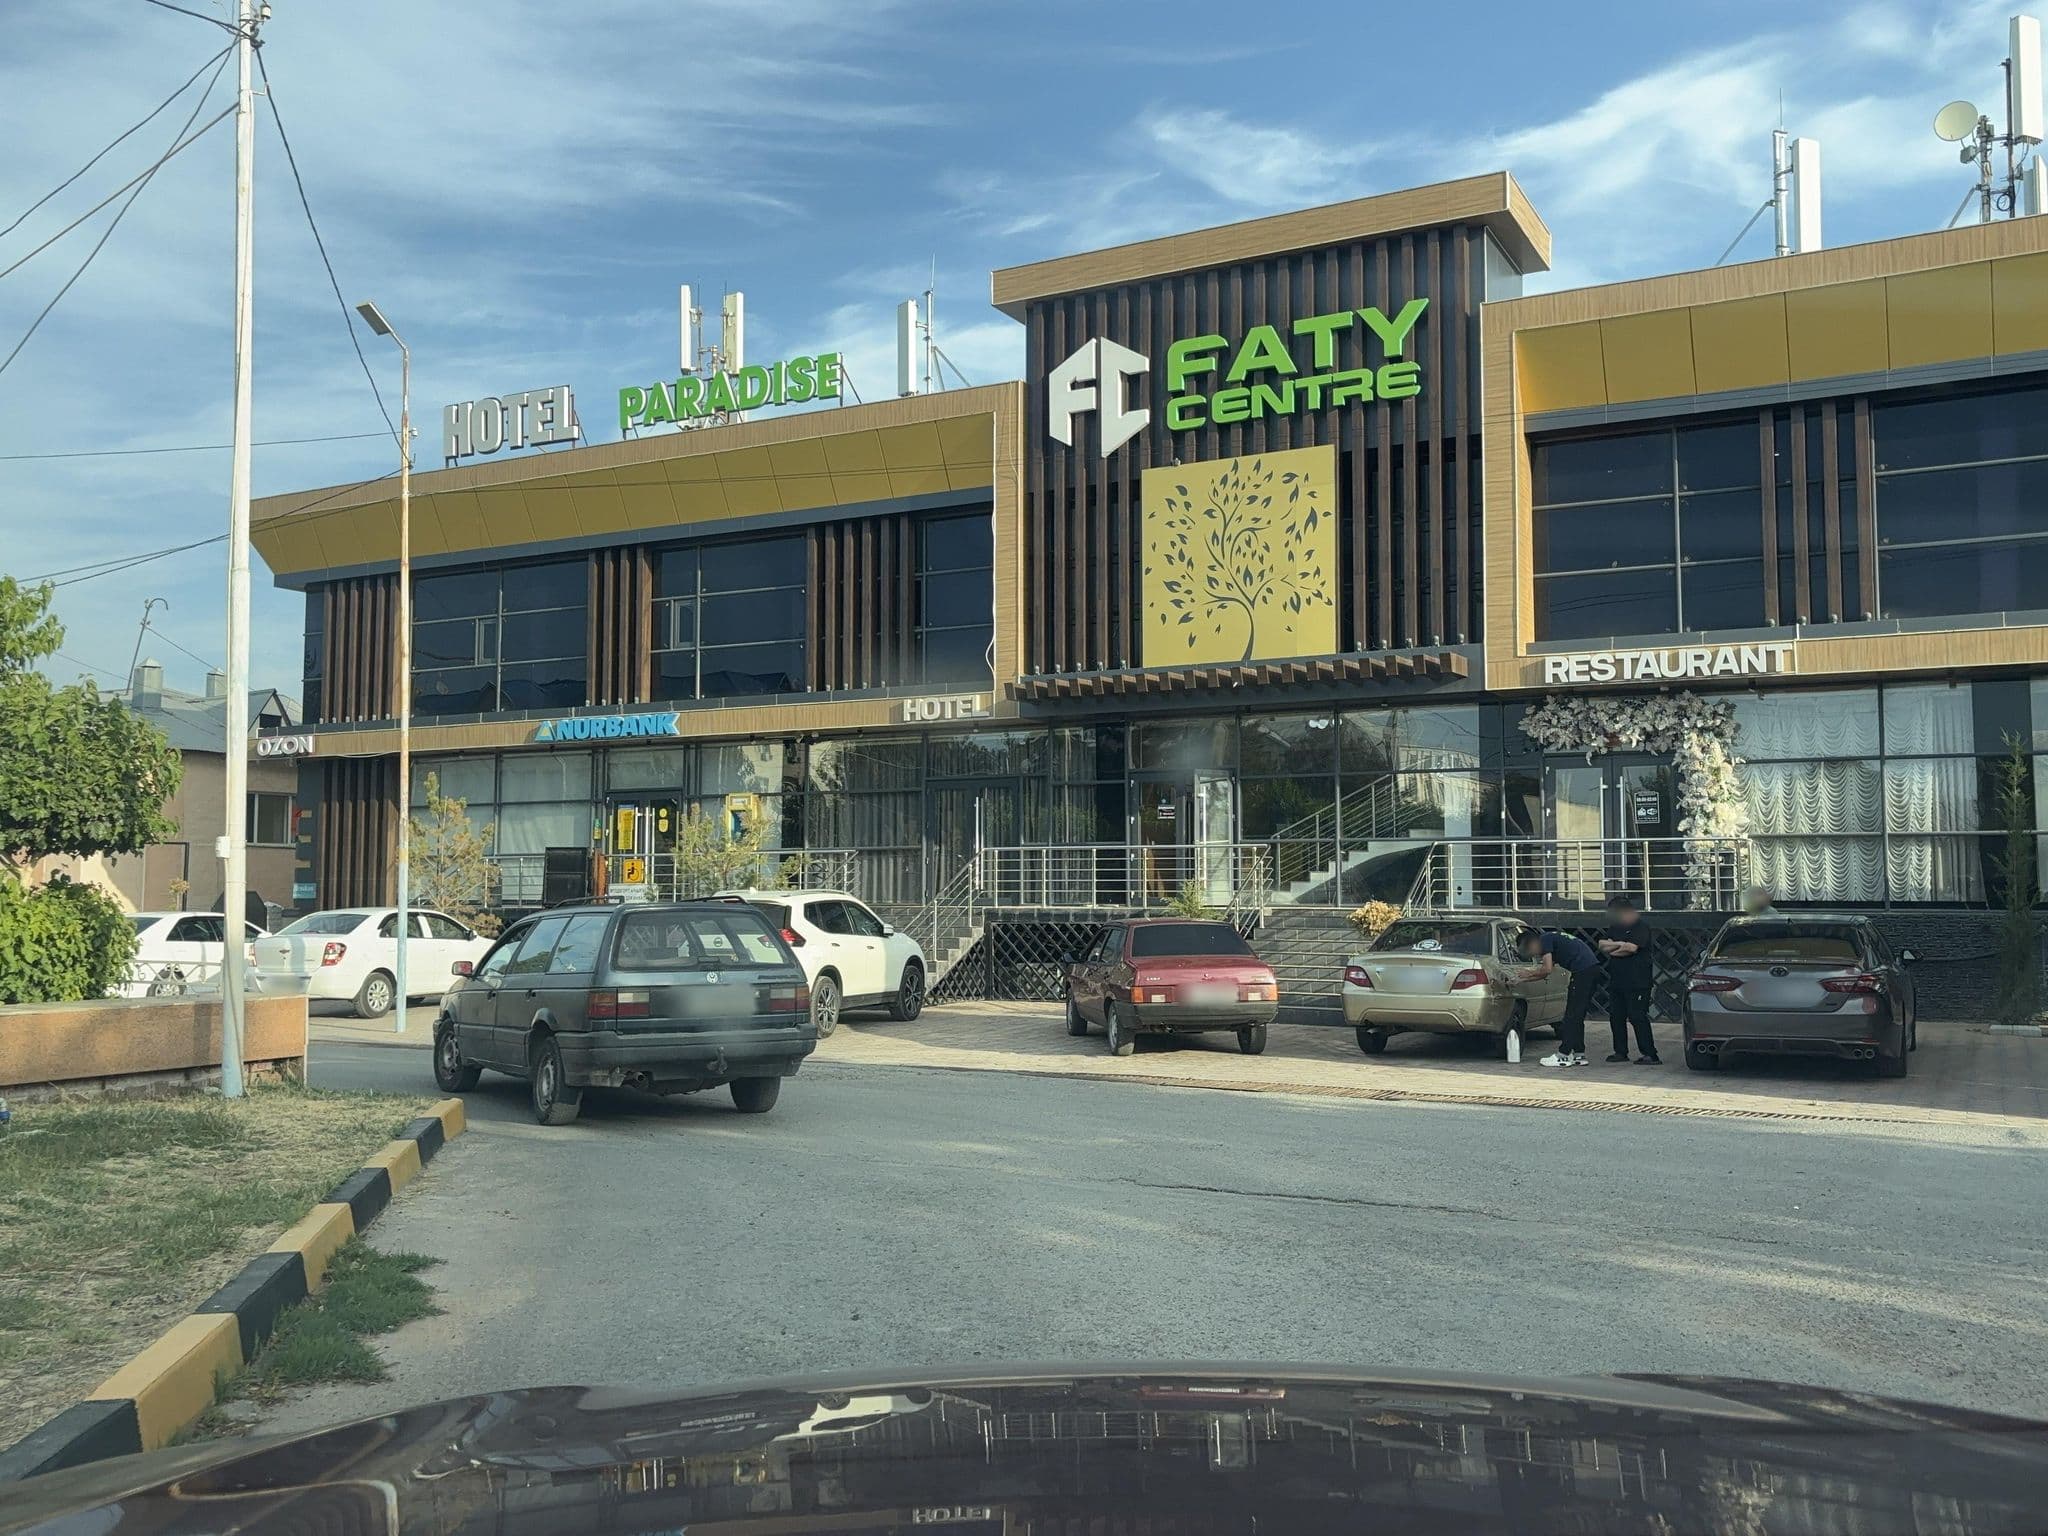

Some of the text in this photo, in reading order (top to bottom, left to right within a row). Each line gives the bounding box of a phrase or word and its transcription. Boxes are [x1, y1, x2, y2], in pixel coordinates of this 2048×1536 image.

[1167, 298, 1429, 392] FATY
[444, 352, 842, 459] HOTEL PARADISE
[1166, 362, 1421, 431] CENTRE
[1544, 643, 1792, 684] RESTAURANT
[555, 714, 680, 741] NURBANK
[903, 694, 989, 721] HOTEL
[257, 735, 314, 756] OZON
